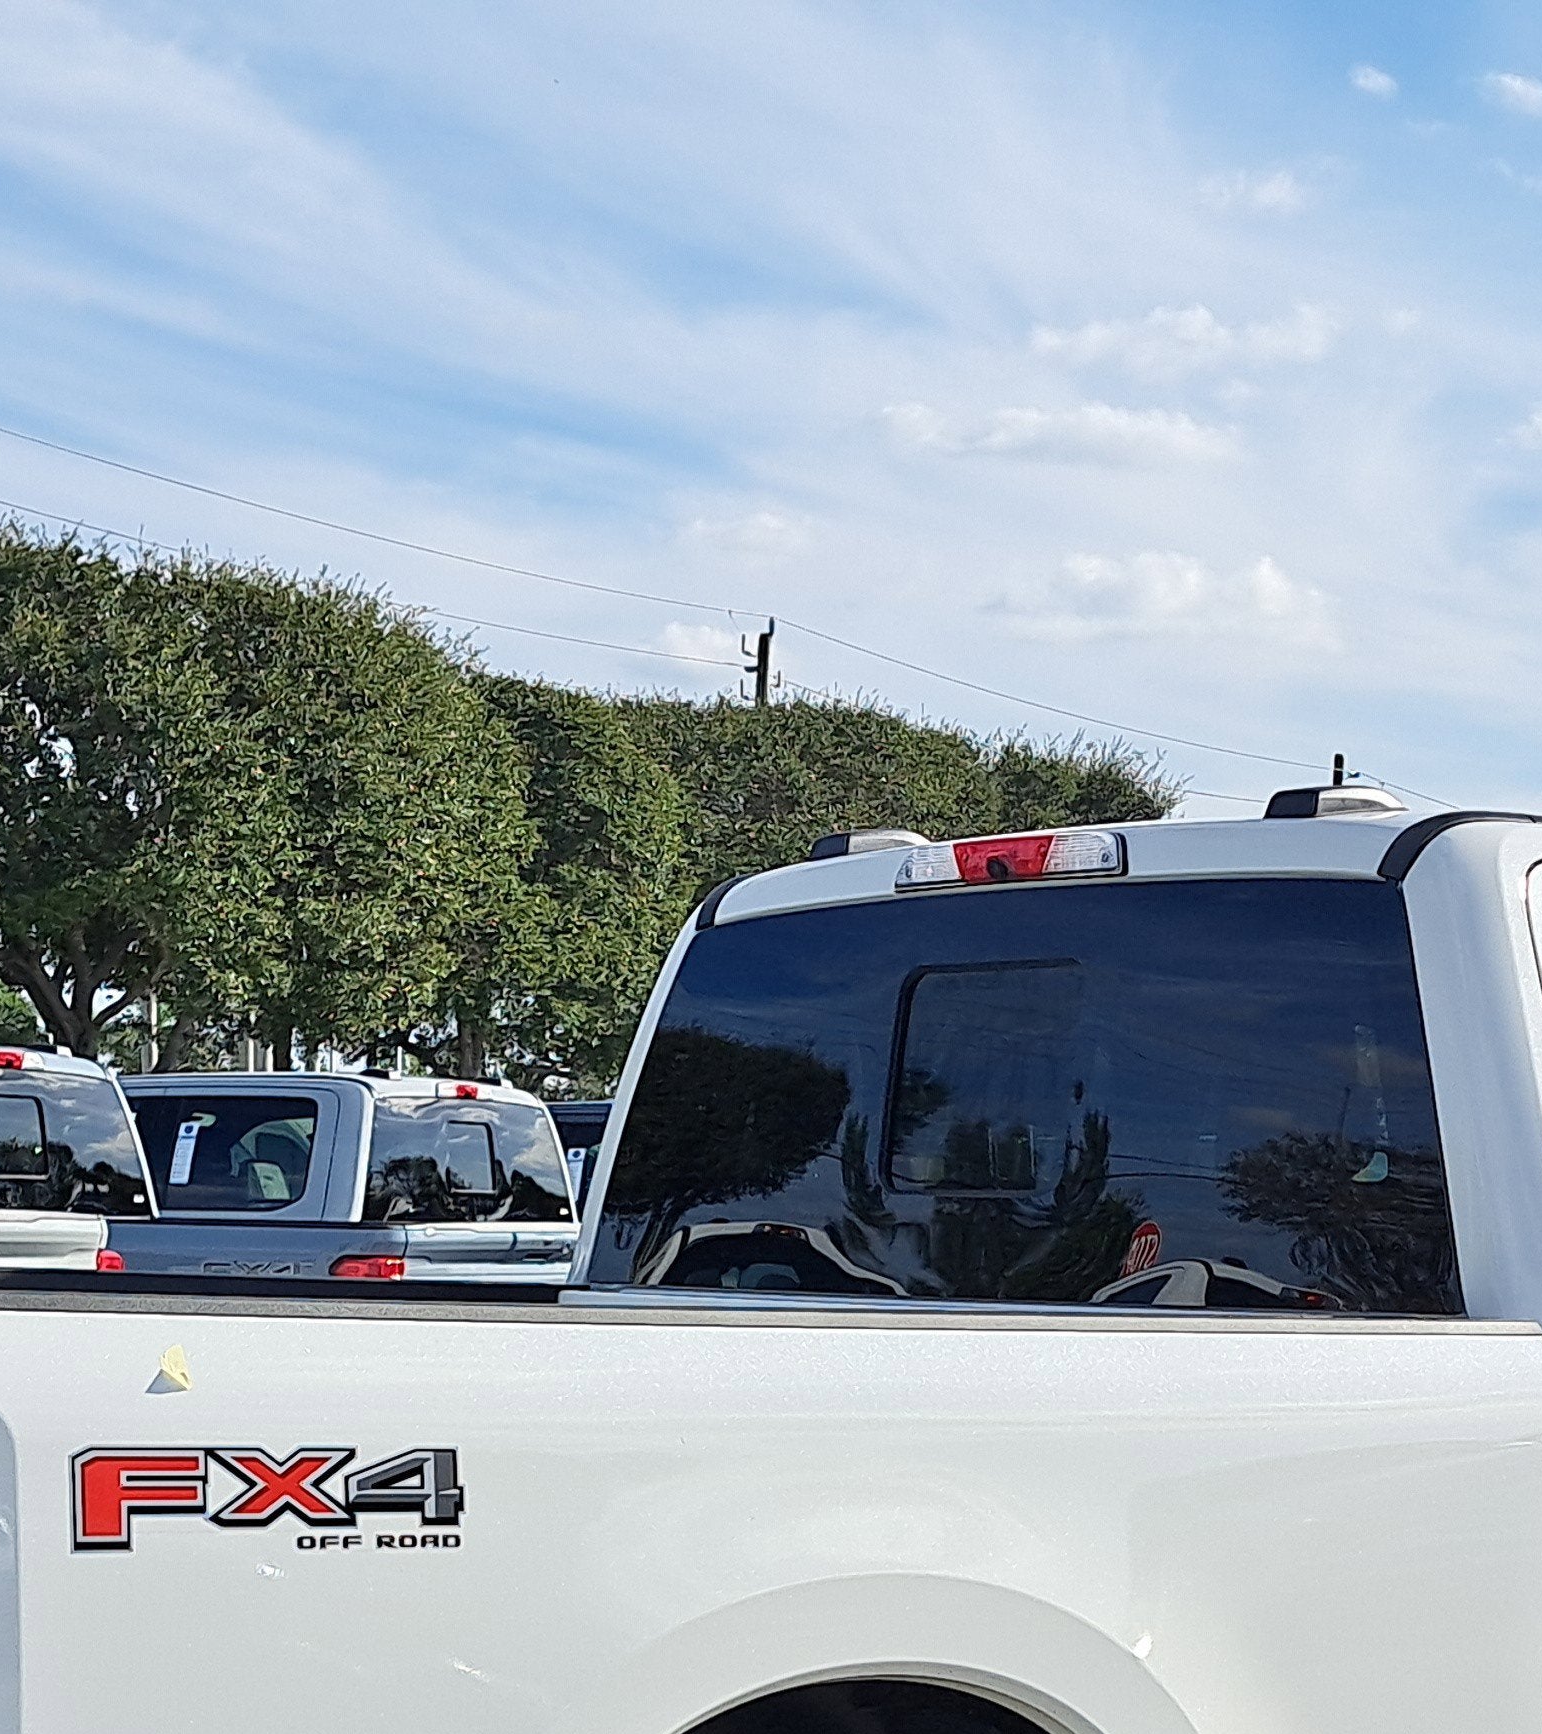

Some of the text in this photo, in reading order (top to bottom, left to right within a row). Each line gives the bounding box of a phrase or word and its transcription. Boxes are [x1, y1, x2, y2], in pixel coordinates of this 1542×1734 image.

[71, 1446, 464, 1553] FX4
[296, 1534, 462, 1550] OFF ROAD
